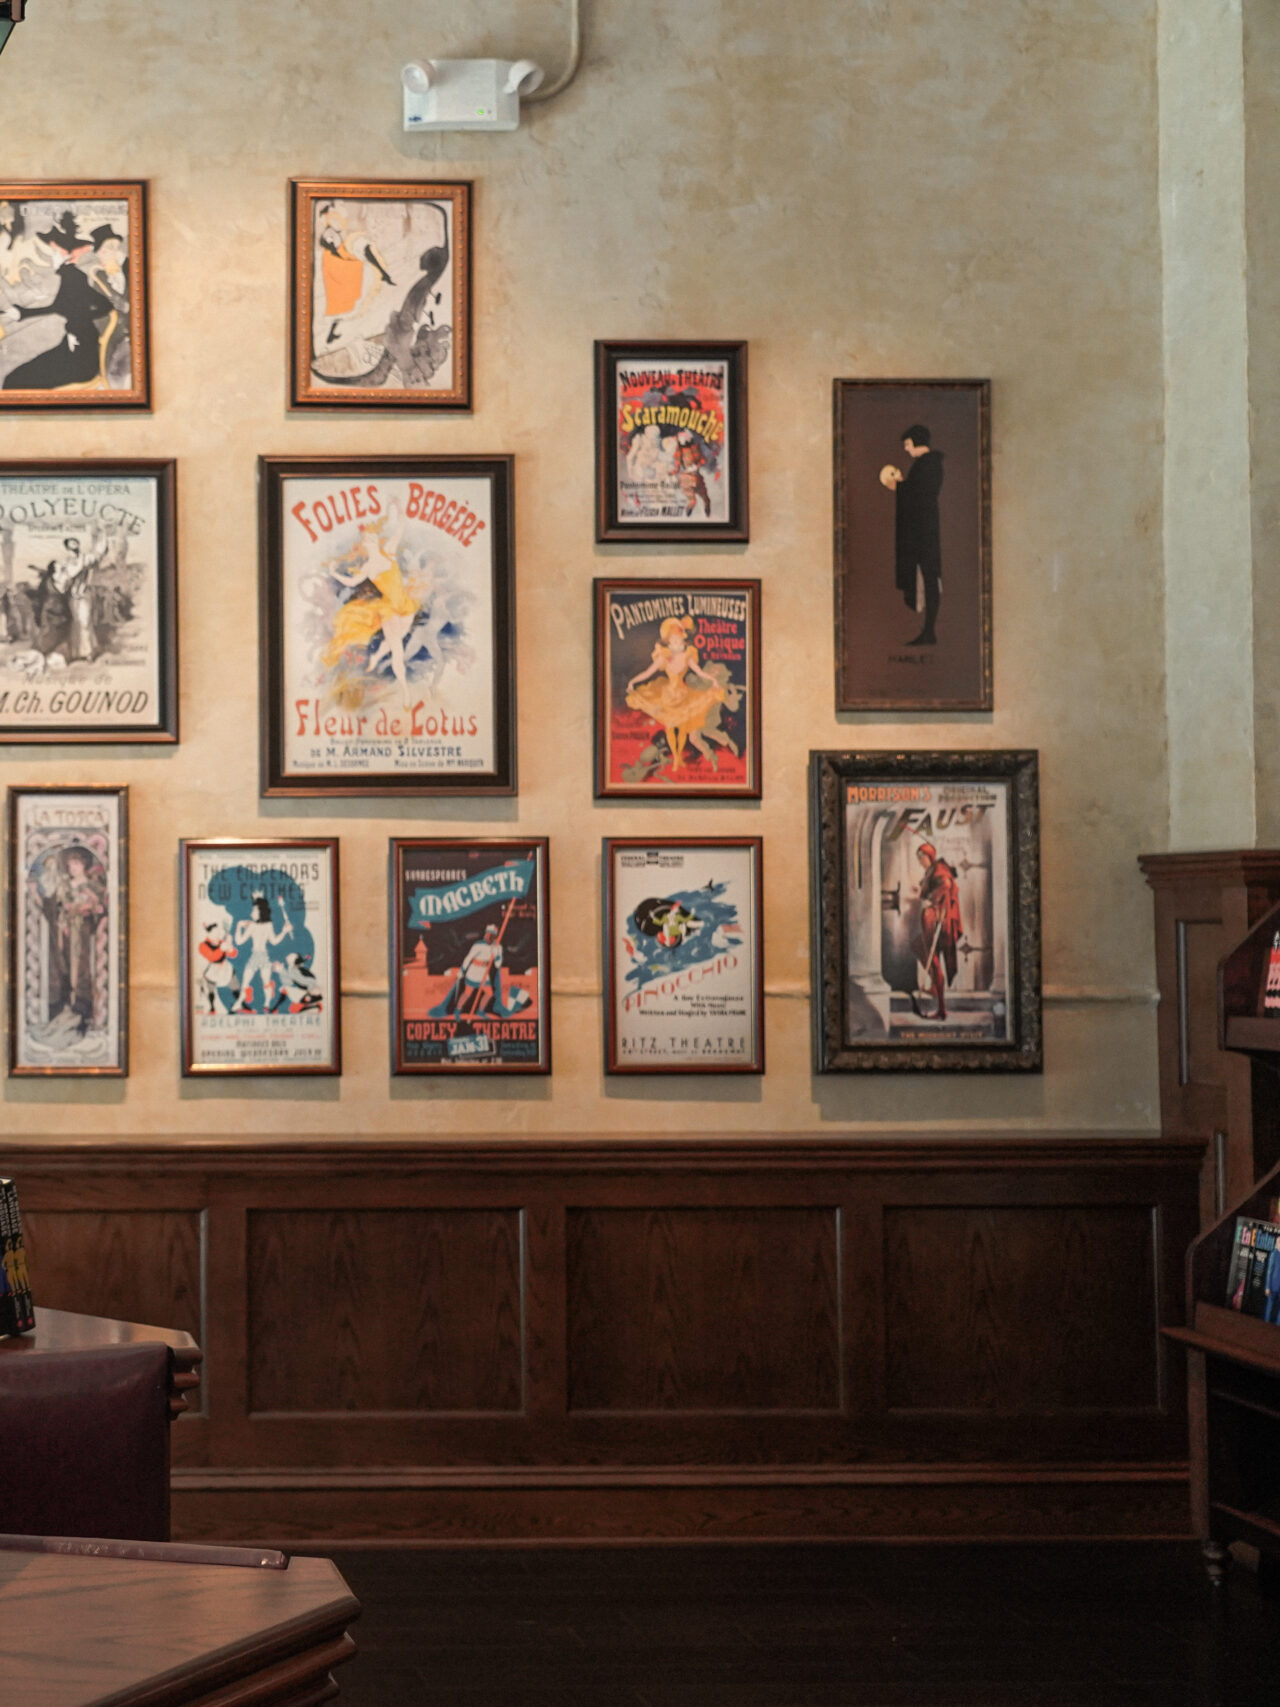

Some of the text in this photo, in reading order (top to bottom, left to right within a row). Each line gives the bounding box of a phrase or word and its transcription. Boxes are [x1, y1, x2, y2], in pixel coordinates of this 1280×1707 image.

[622, 404, 724, 443] Scaramouche
[292, 485, 381, 542] FOLIES
[611, 594, 745, 640] PANTOMIMES LUMINEUSES
[50, 691, 149, 714] GOUNOD
[295, 699, 478, 736] Fleur de Lotus
[398, 746, 462, 757] SILVESTRE
[888, 804, 995, 841] FAUST
[203, 864, 227, 880] THE
[198, 883, 305, 901] NEW CLOTHES
[419, 870, 524, 916] MACBETH
[406, 1022, 536, 1040] COPLEY THEATRE
[670, 1037, 745, 1048] THEATRE
